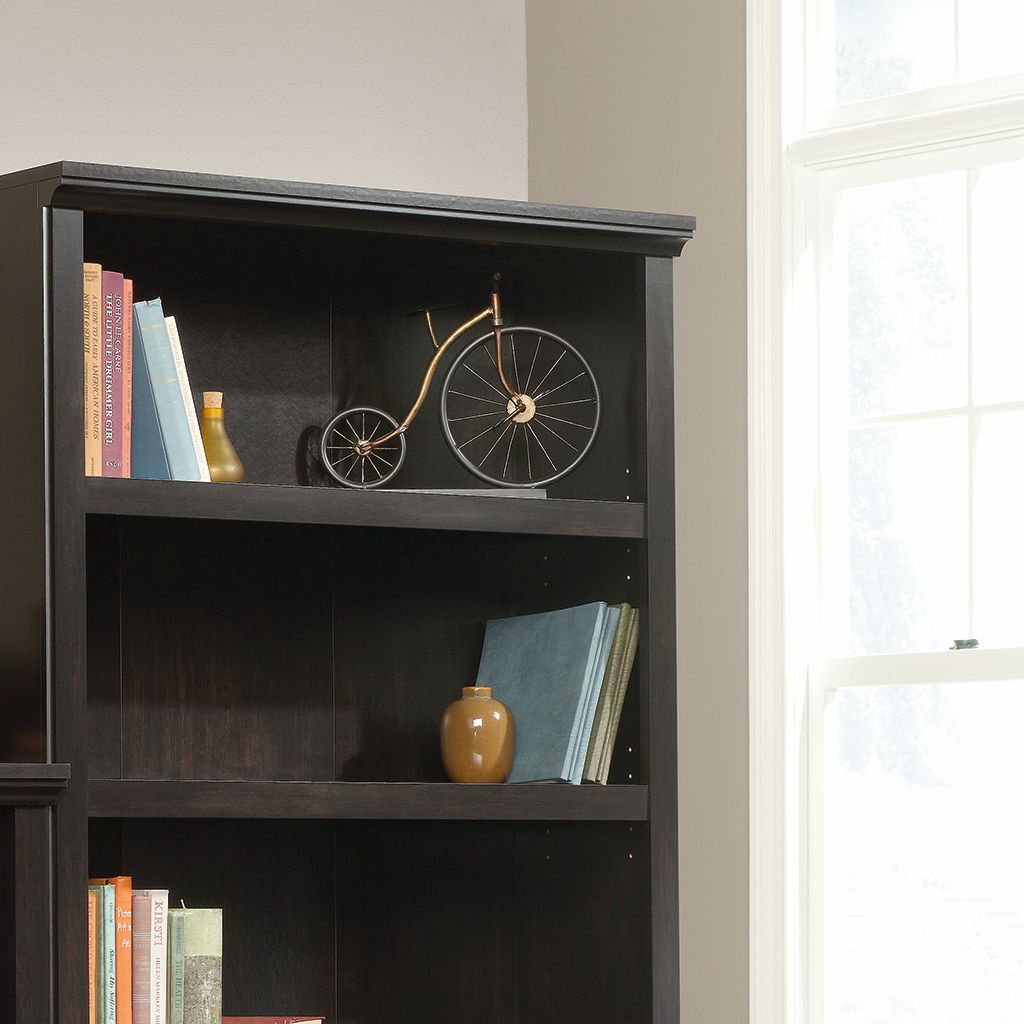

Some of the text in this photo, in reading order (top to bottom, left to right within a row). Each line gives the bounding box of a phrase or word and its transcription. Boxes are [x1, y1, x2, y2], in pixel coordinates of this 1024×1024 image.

[115, 294, 123, 323] JOHN
[92, 327, 98, 337] TO
[105, 319, 113, 356] LITTLE
[105, 360, 113, 417] DRUMMER
[105, 419, 113, 446] GIRL
[154, 901, 163, 945] KIRSTI
